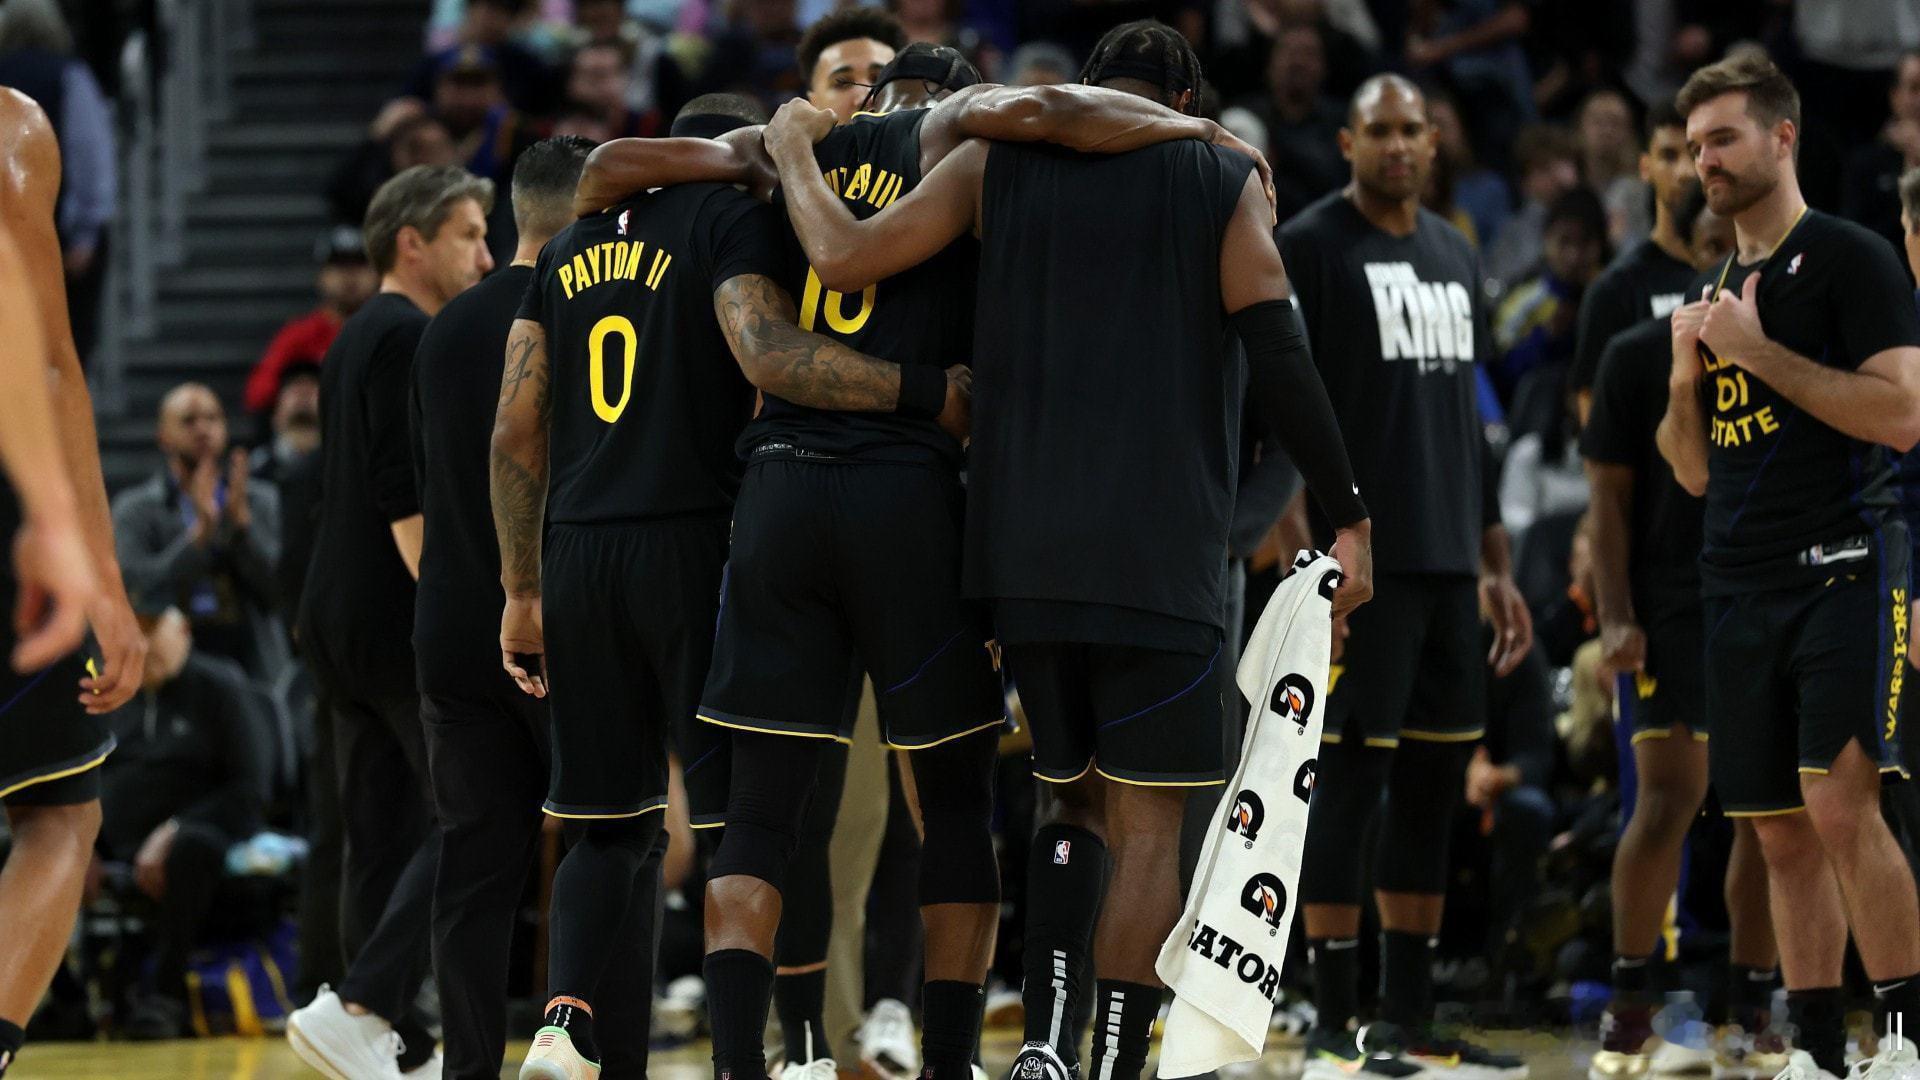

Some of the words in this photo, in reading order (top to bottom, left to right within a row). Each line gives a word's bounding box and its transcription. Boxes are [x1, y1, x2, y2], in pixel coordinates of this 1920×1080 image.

[558, 241, 645, 300] PAYTON
[645, 248, 672, 291] II
[1371, 281, 1475, 361] KING
[589, 315, 637, 424] 0
[1885, 587, 1908, 740] WARRIORS
[1187, 919, 1279, 1003] ATOR
